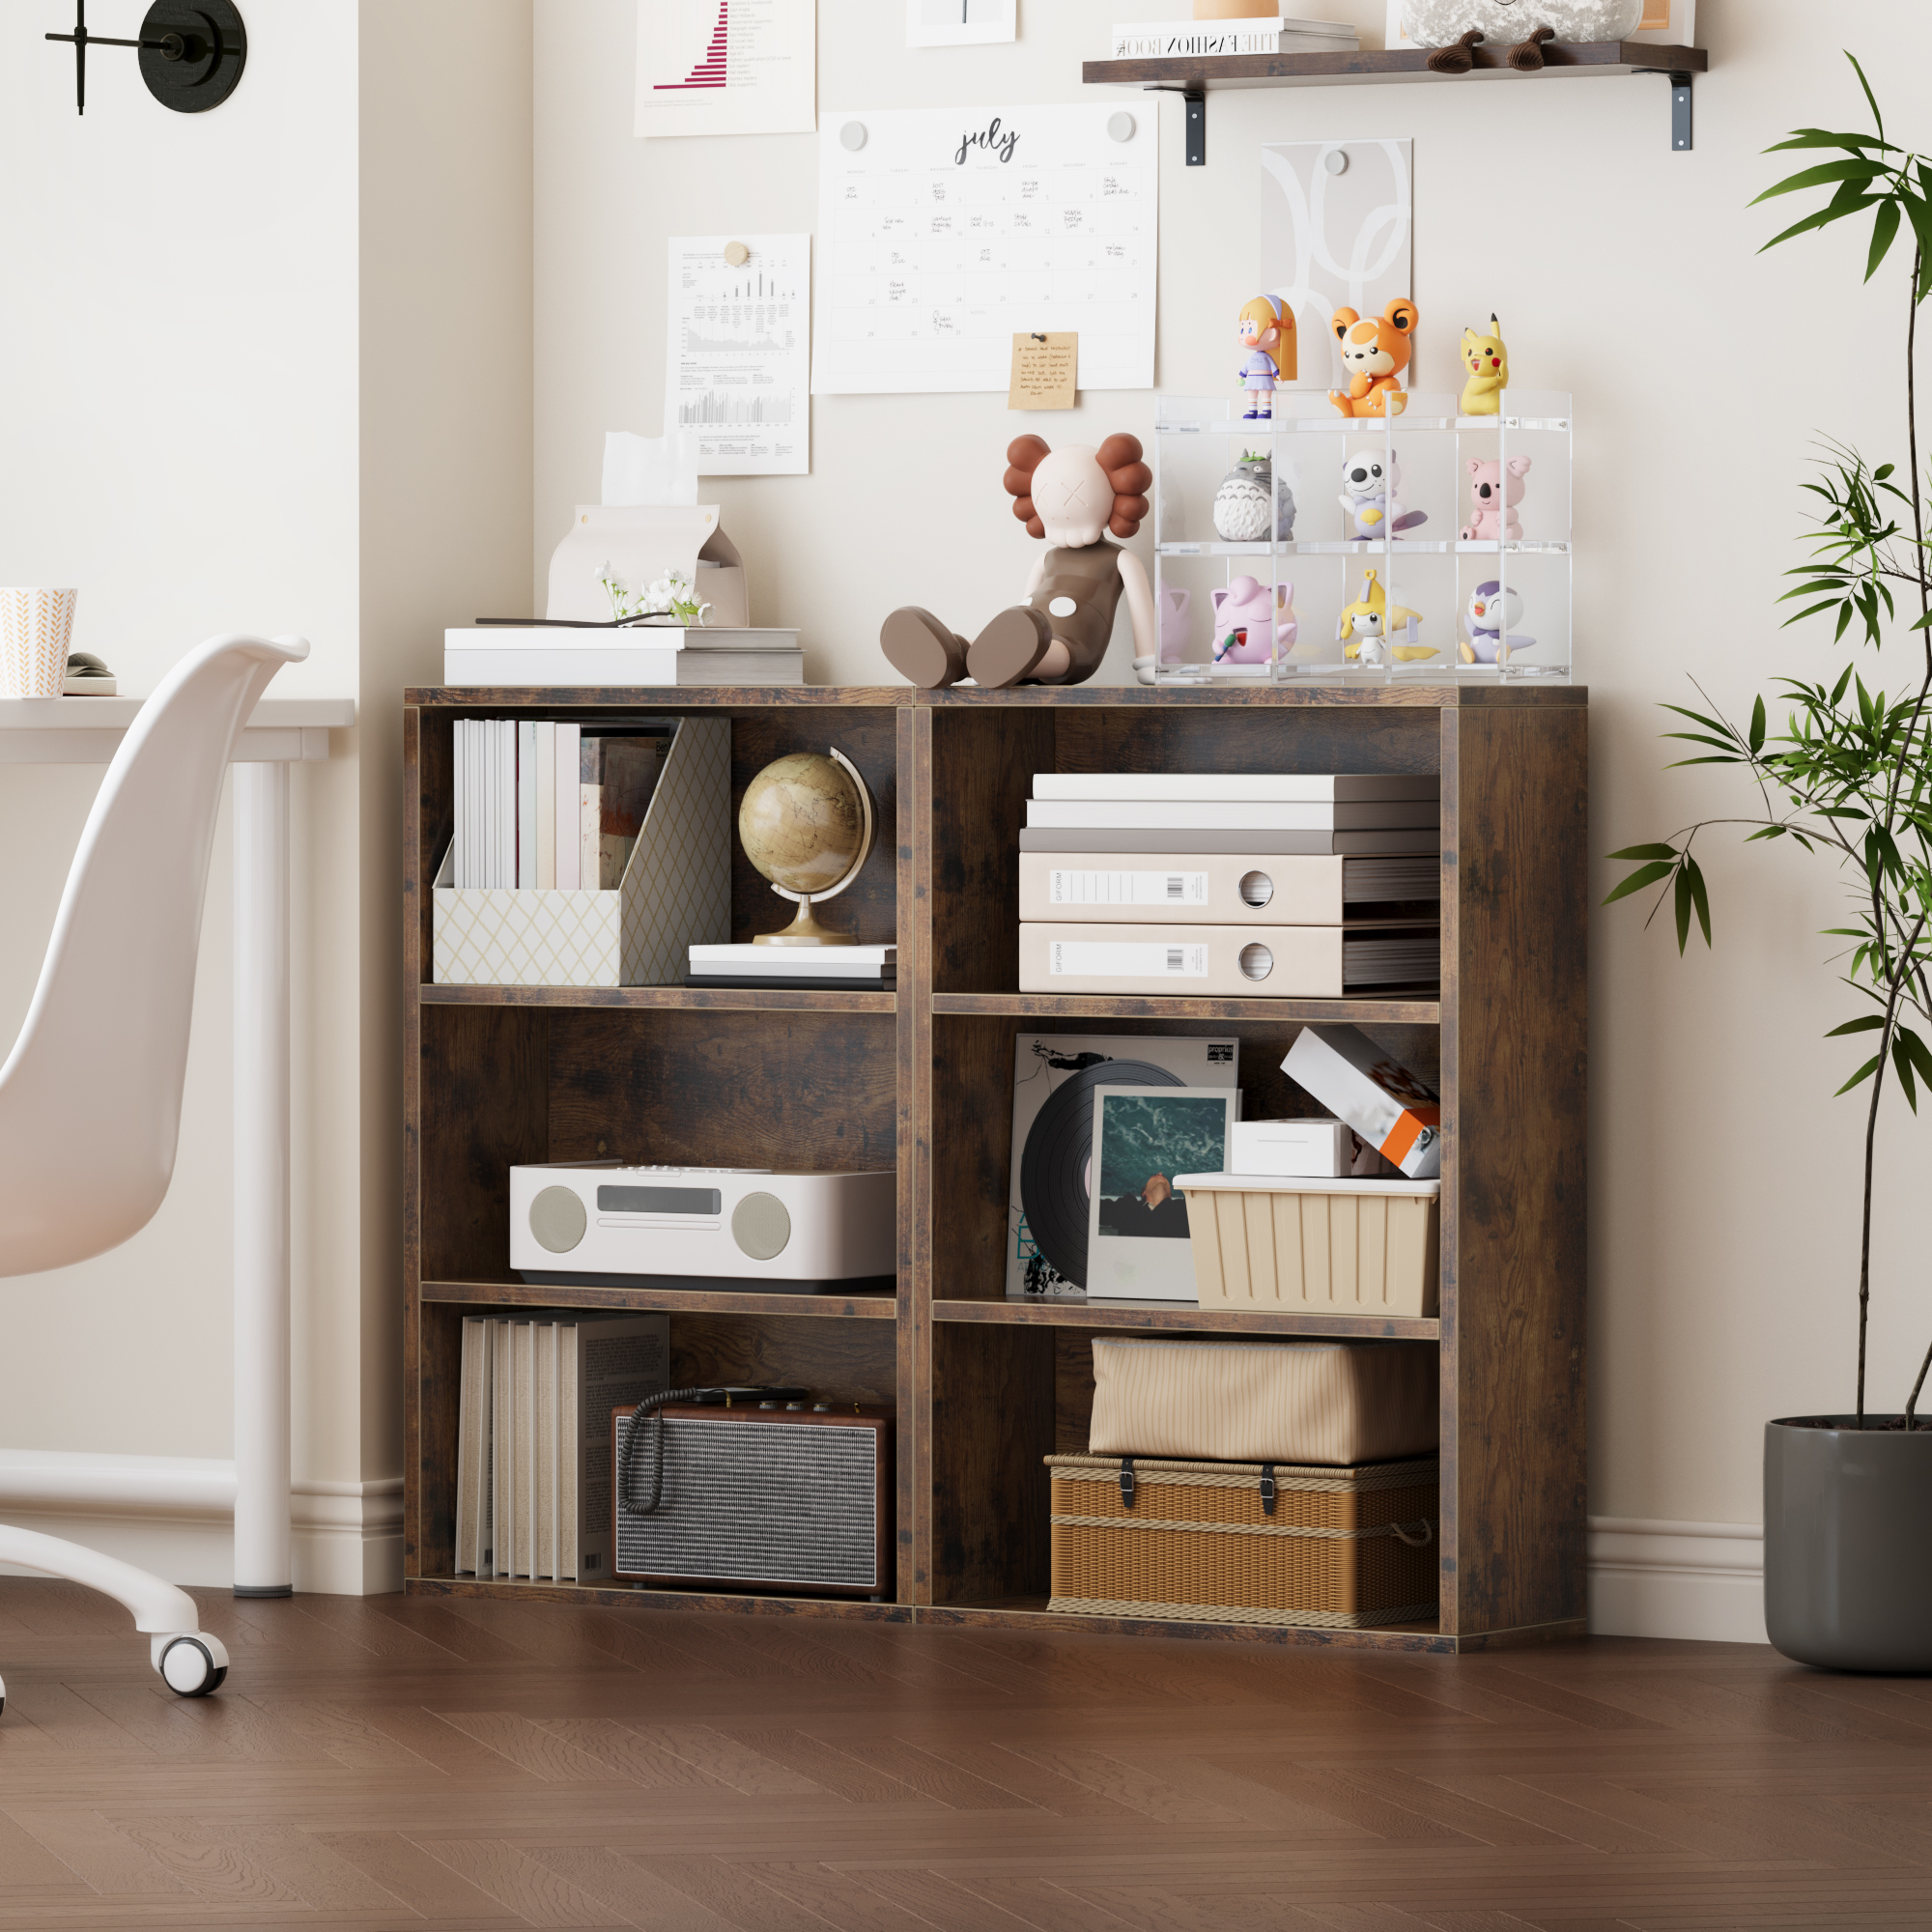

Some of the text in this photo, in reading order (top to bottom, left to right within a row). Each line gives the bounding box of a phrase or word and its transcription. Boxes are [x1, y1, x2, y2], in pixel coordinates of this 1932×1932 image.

[954, 117, 1021, 165] july
[656, 741, 668, 752] Ben
[1208, 1045, 1234, 1054] proprius
